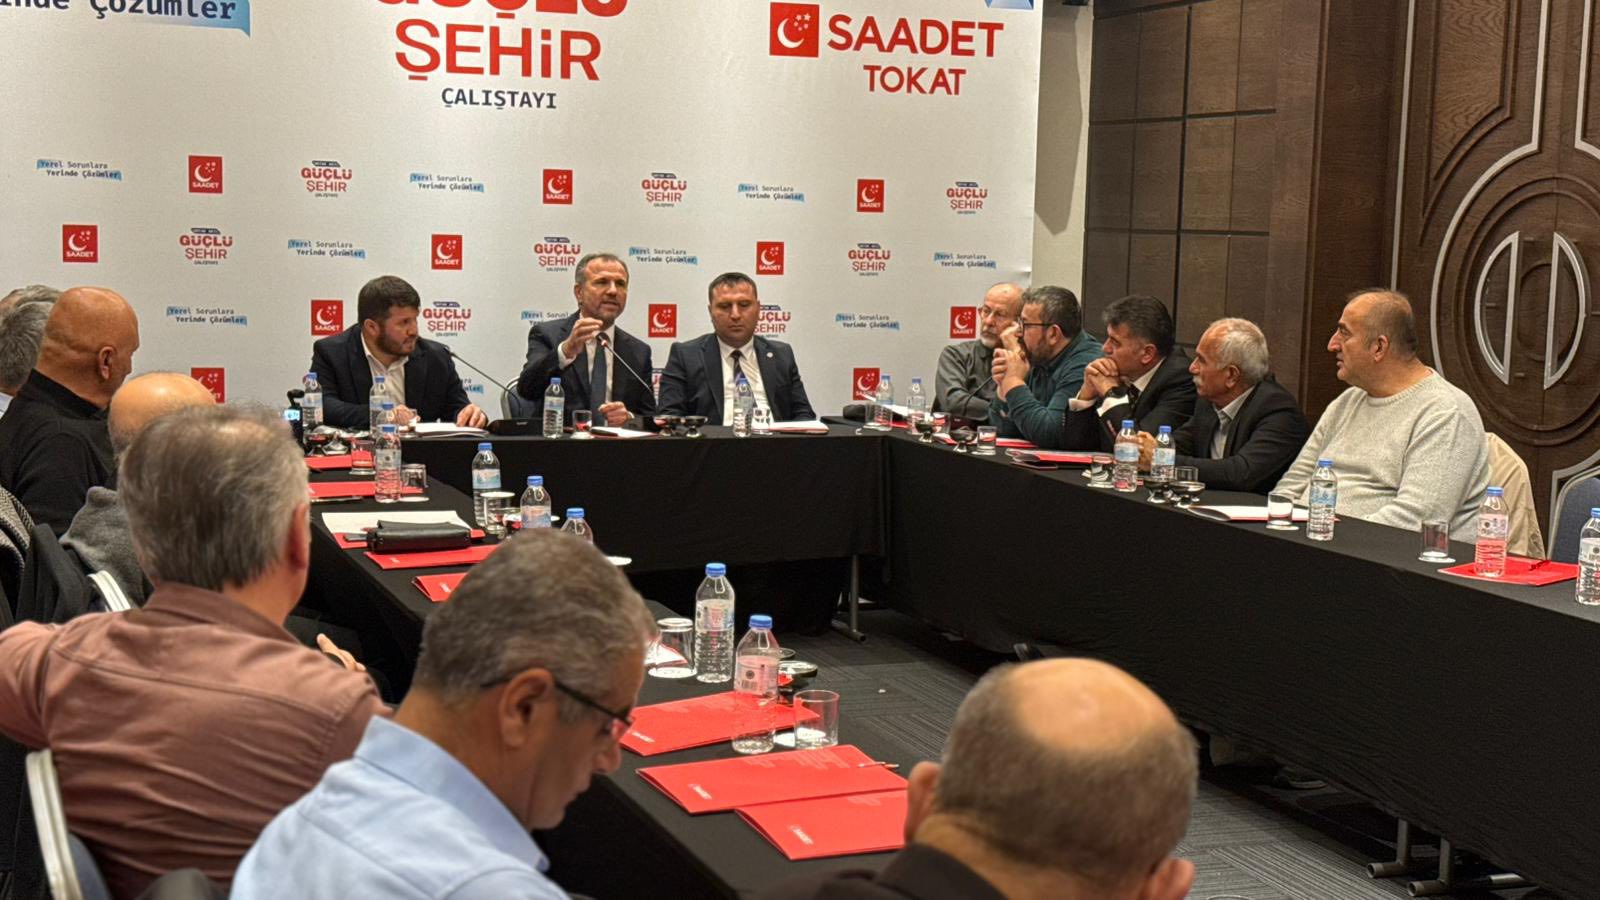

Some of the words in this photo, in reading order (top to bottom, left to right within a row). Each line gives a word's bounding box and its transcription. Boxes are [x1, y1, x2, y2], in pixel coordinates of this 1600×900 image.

[827, 14, 1004, 58] SAADET
[863, 65, 967, 96] TOKAT
[441, 88, 557, 110] ÇALIŞTAYI
[301, 167, 352, 180] GÜÇLÜ
[641, 179, 687, 191] GÜÇLÜ
[946, 188, 988, 199] GÜÇLÜ
[180, 235, 233, 248] GÜÇLÜ
[534, 243, 581, 256] GÜÇLÜ
[848, 250, 891, 261] GÜÇLÜ
[422, 308, 471, 320] GÜÇLÜ
[758, 312, 791, 323] ÜÇLÜ
